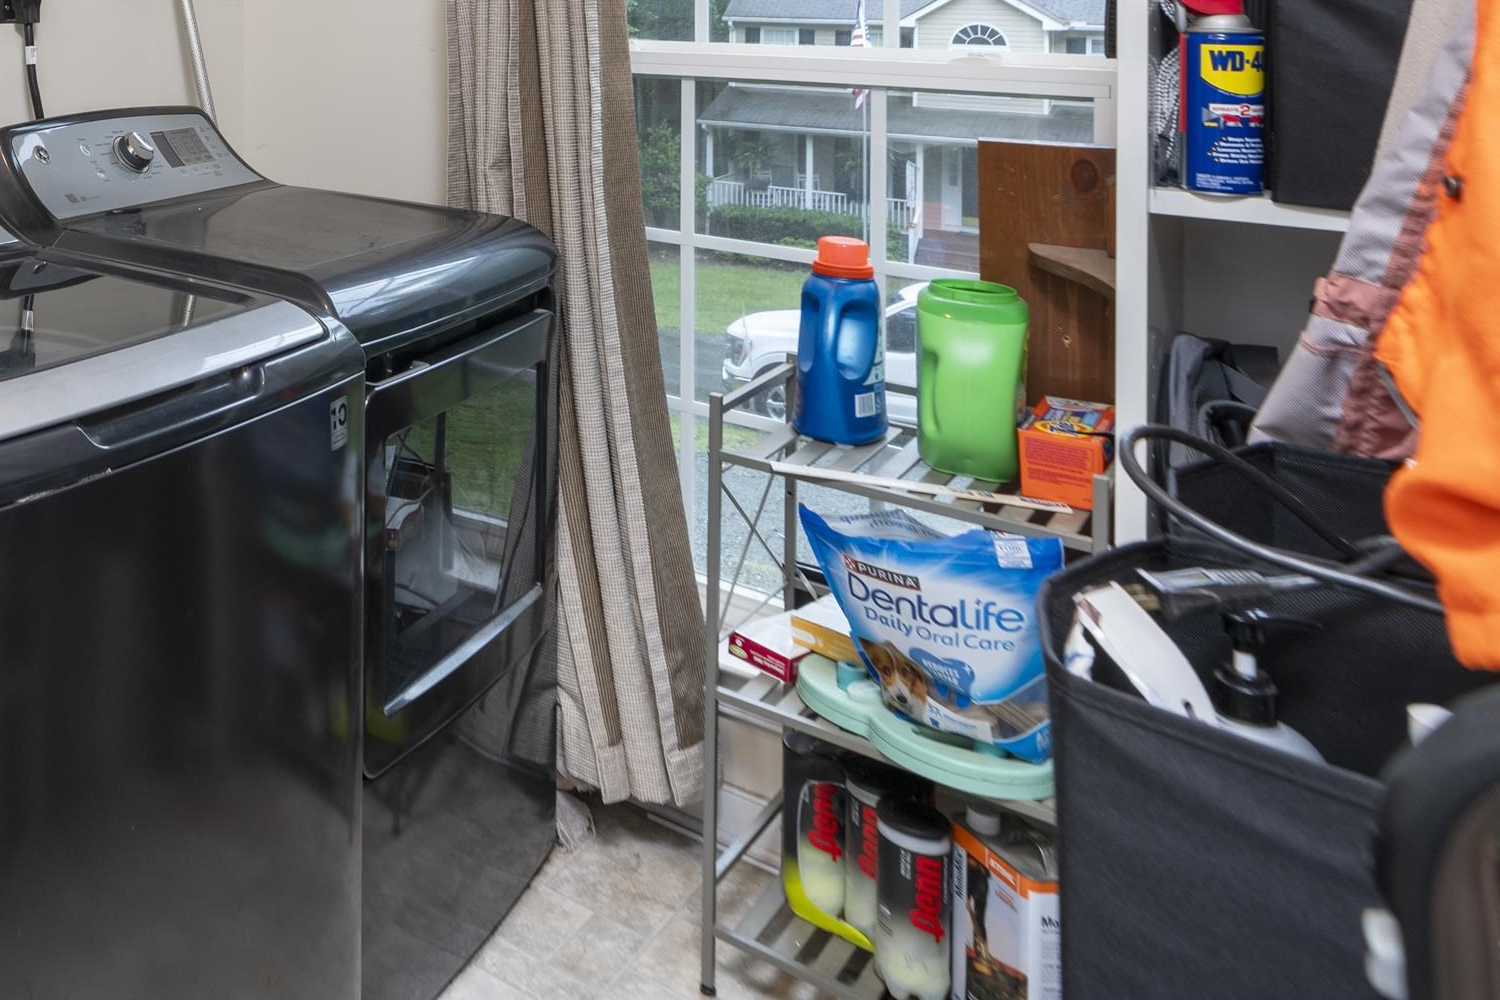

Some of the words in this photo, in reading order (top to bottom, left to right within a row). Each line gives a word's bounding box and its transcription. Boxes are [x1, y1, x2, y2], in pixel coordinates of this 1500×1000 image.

[858, 564, 917, 588] PURINA
[864, 605, 912, 637] Daily
[916, 626, 959, 647] Oral
[964, 634, 1015, 651] Care
[807, 783, 843, 863] penn
[954, 853, 965, 899] MotoMix
[909, 855, 945, 945] penn
